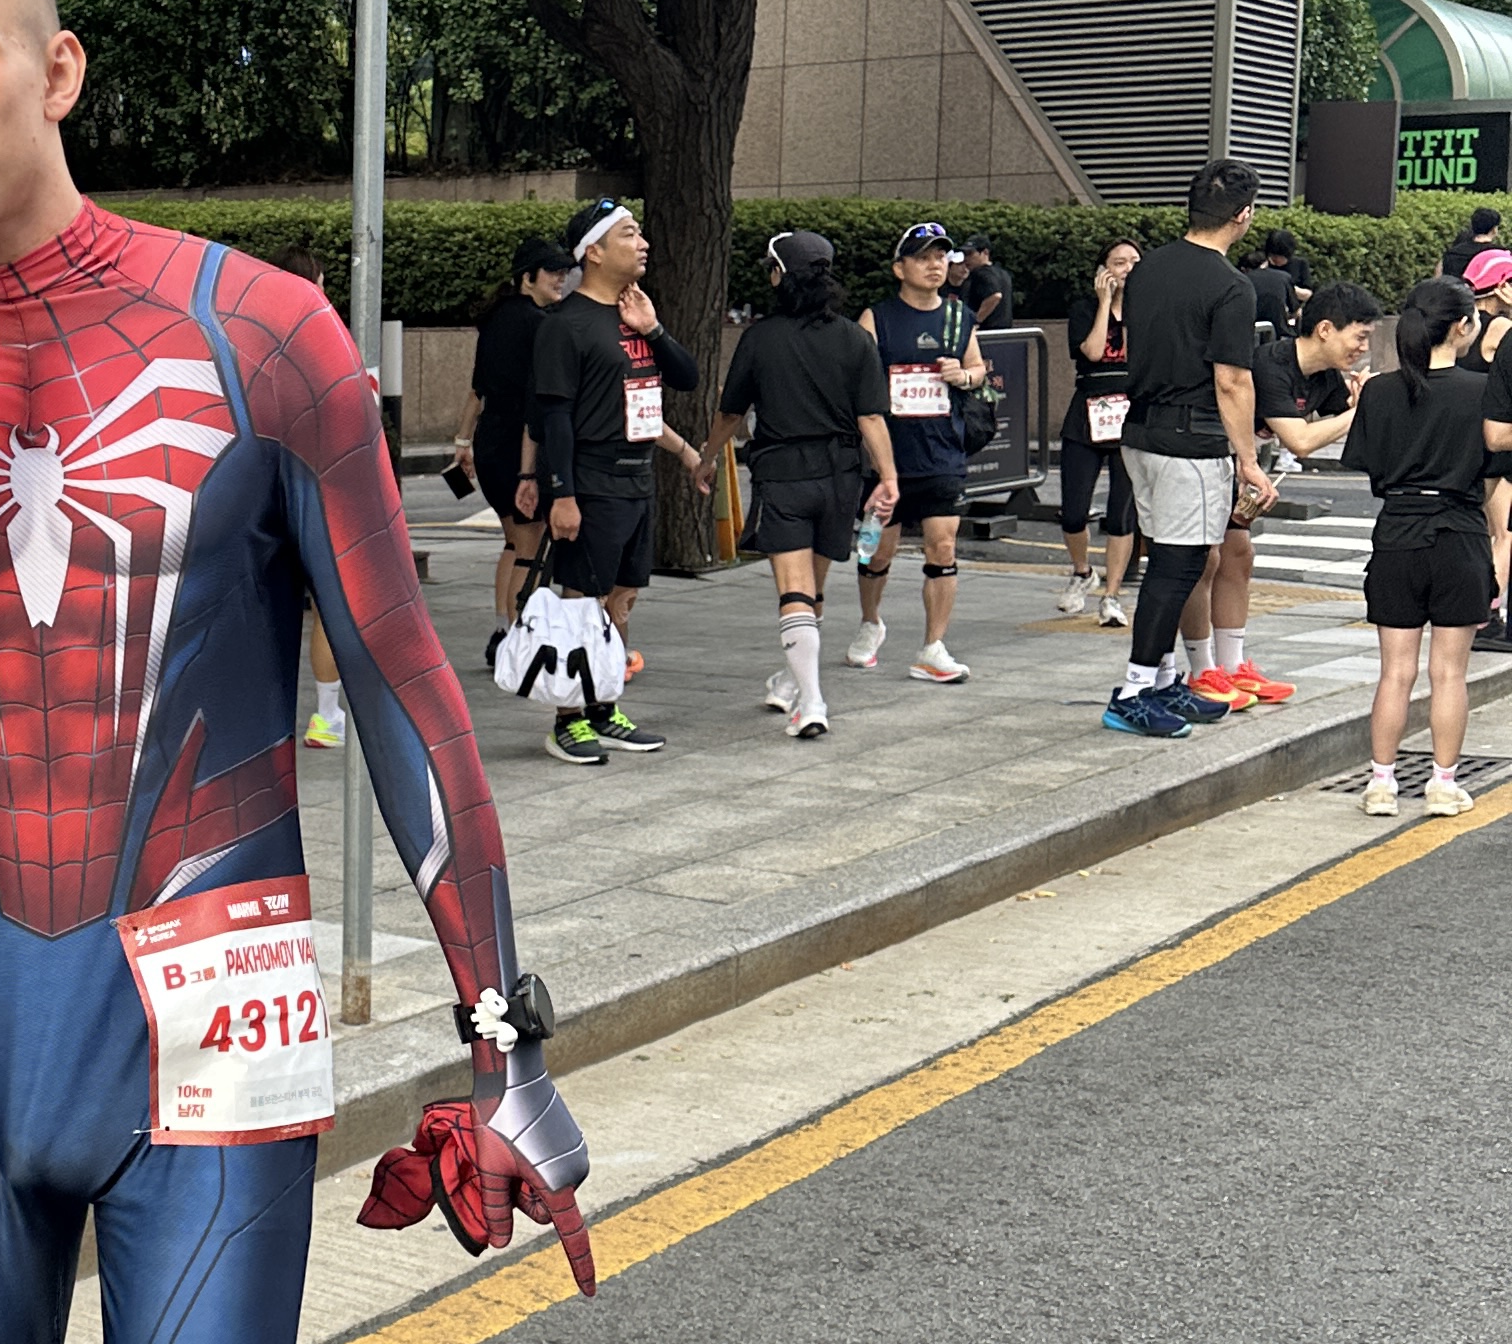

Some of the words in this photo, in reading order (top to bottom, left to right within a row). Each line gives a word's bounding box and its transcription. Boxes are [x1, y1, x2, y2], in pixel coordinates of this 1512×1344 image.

[1399, 128, 1480, 157] TFIT
[1396, 157, 1478, 186] OUND
[900, 387, 943, 399] 43014
[227, 901, 262, 919] MARVEL
[262, 893, 289, 910] RUN
[162, 963, 186, 991] B
[225, 939, 295, 977] PAKHOMOV
[177, 1085, 213, 1098] 10km
[177, 1103, 206, 1118] 남자
